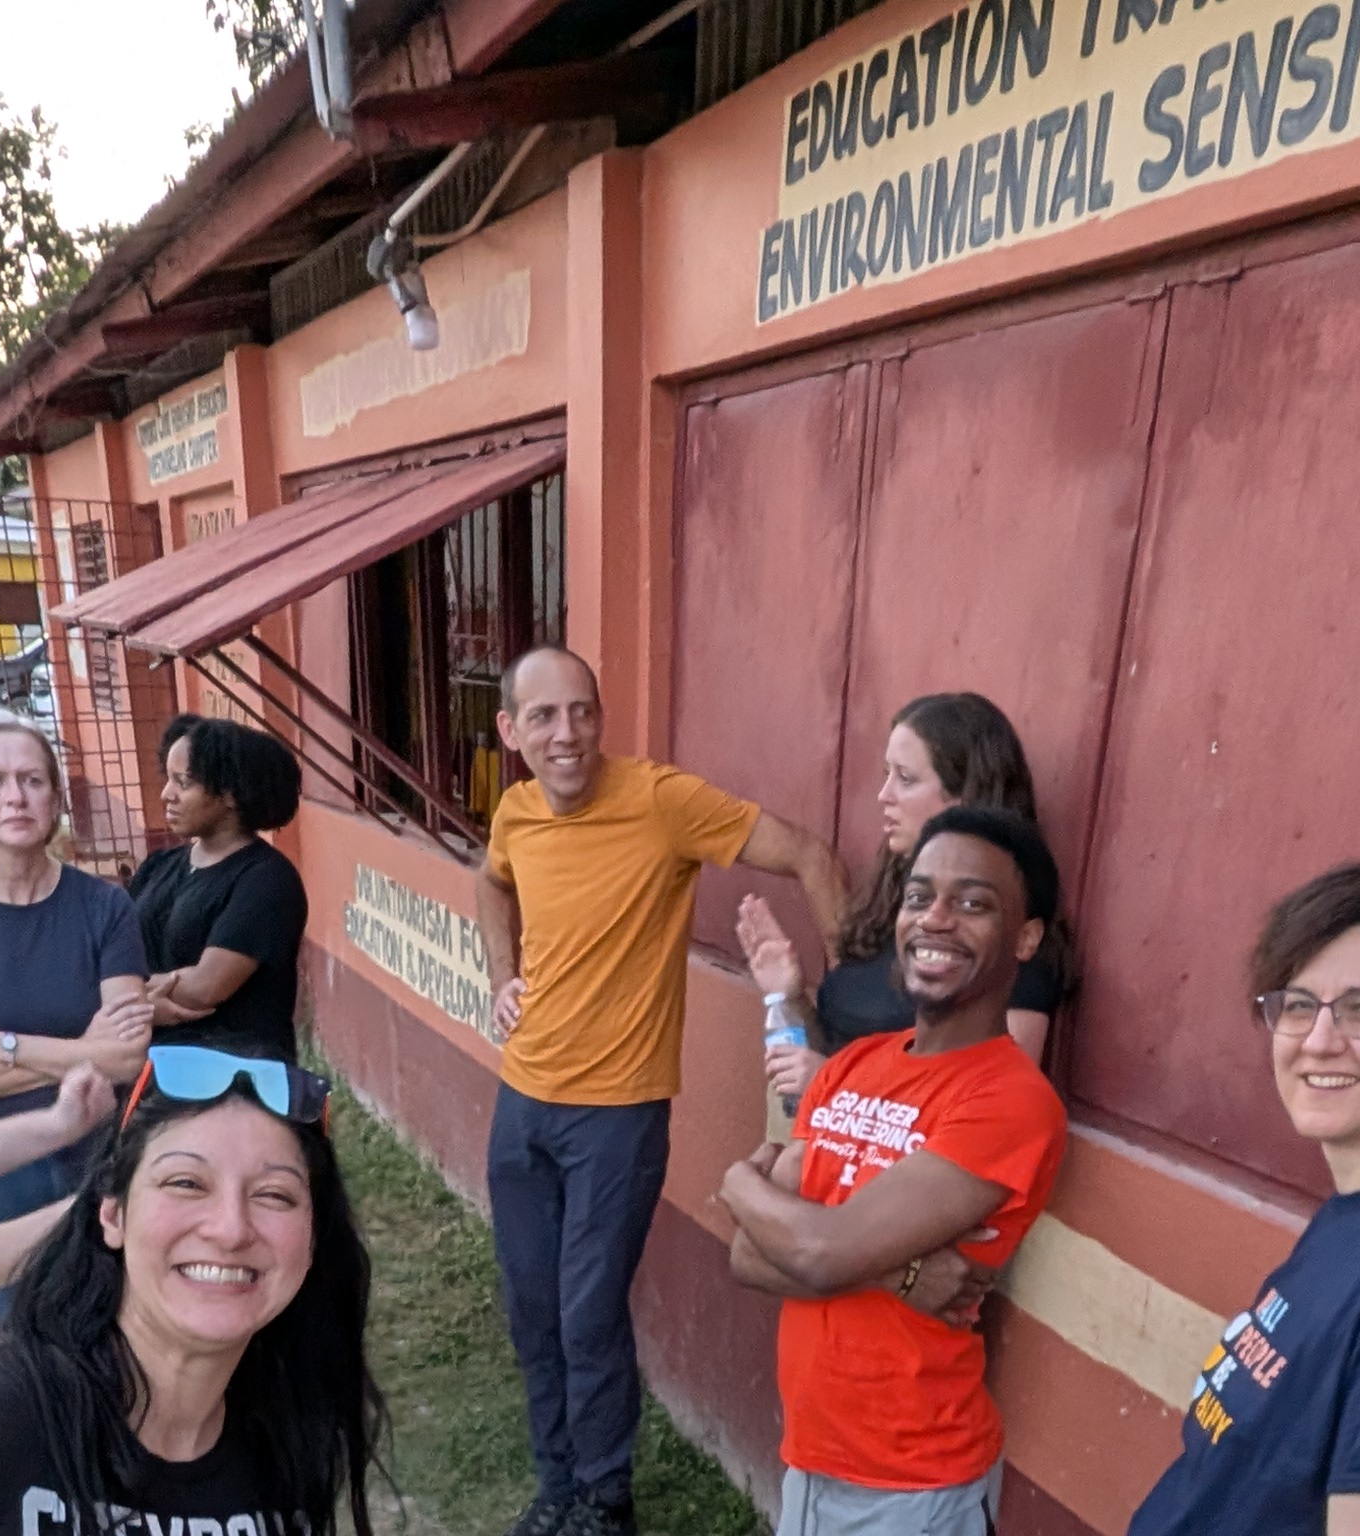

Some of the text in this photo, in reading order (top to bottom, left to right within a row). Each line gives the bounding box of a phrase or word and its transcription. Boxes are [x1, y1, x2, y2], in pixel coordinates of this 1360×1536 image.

[786, 0, 1054, 186] EDUCATION
[757, 90, 1116, 323] ENVIRONMENTAL
[459, 913, 492, 979] FO
[831, 1090, 920, 1128] GRANGER
